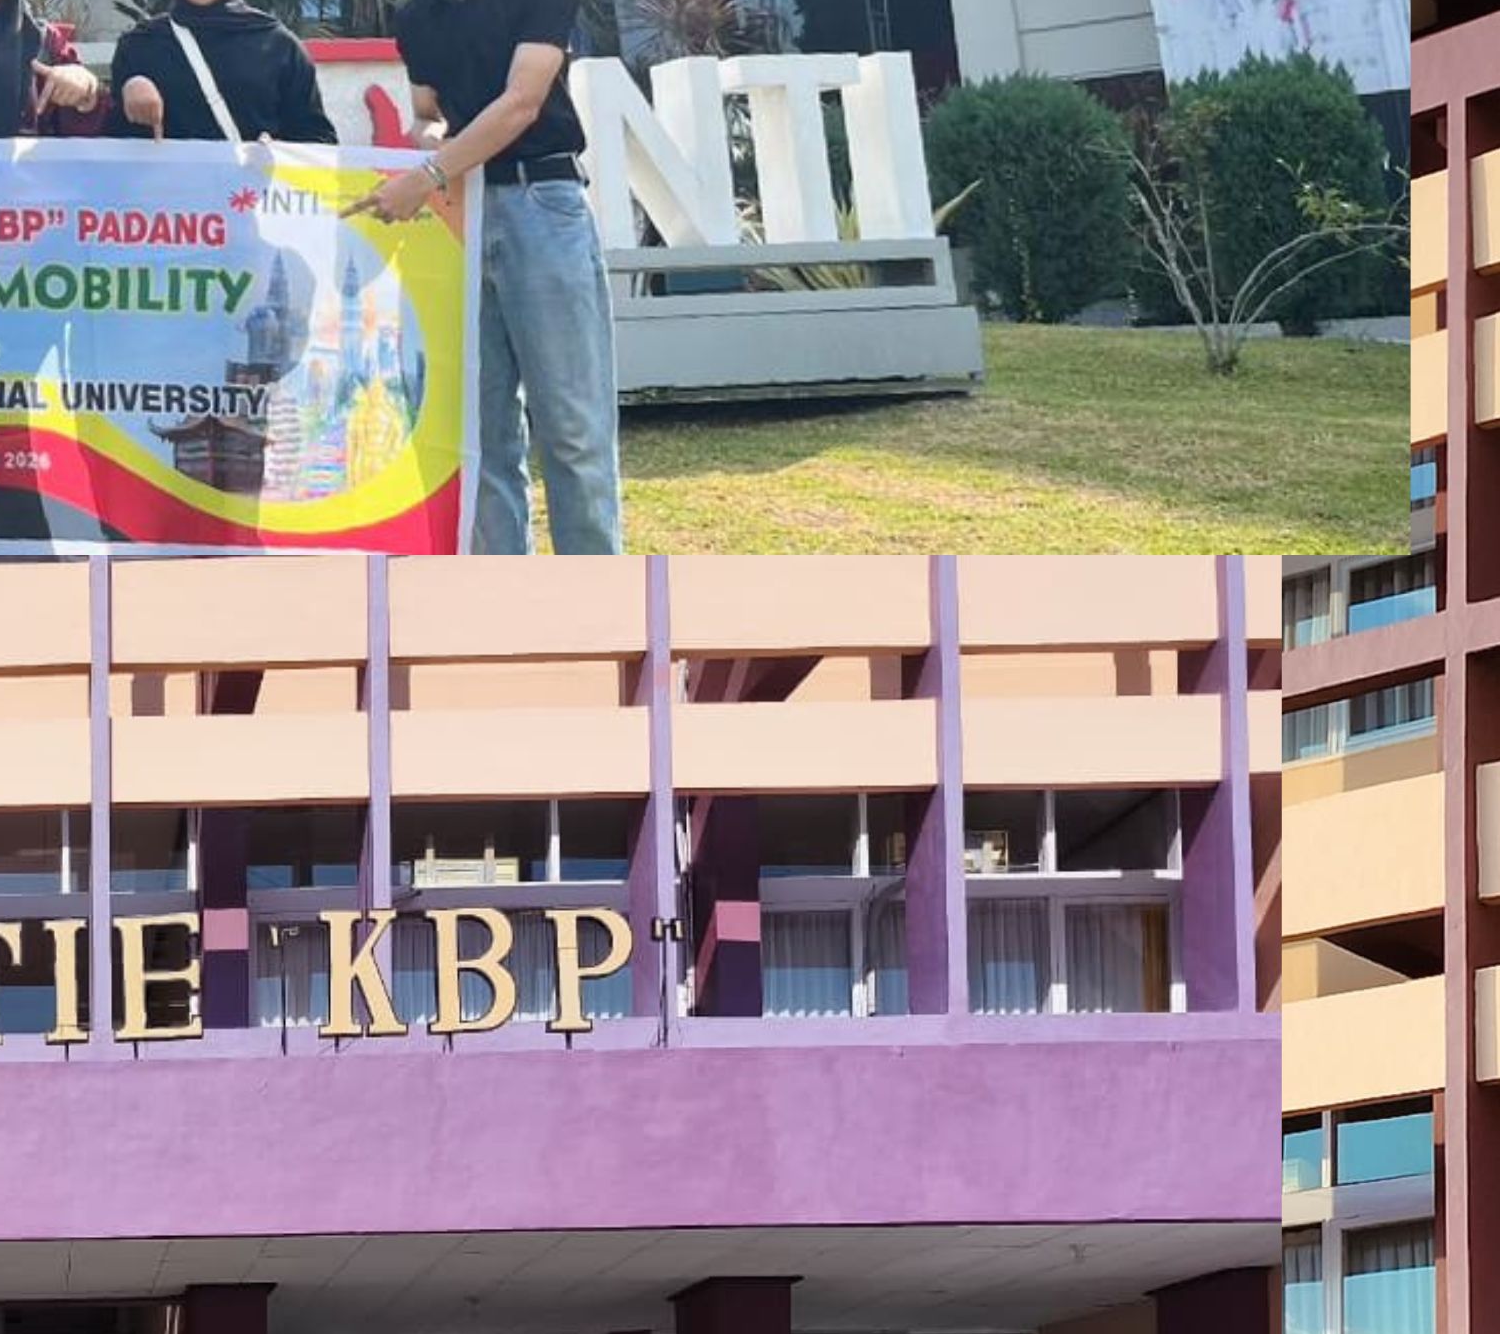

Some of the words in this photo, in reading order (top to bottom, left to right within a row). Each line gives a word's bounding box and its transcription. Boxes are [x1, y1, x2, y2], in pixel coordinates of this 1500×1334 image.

[261, 187, 318, 214] INTI
[78, 210, 225, 247] PADANG
[62, 381, 267, 414] UNIVERSITY
[4, 452, 51, 469] 2026
